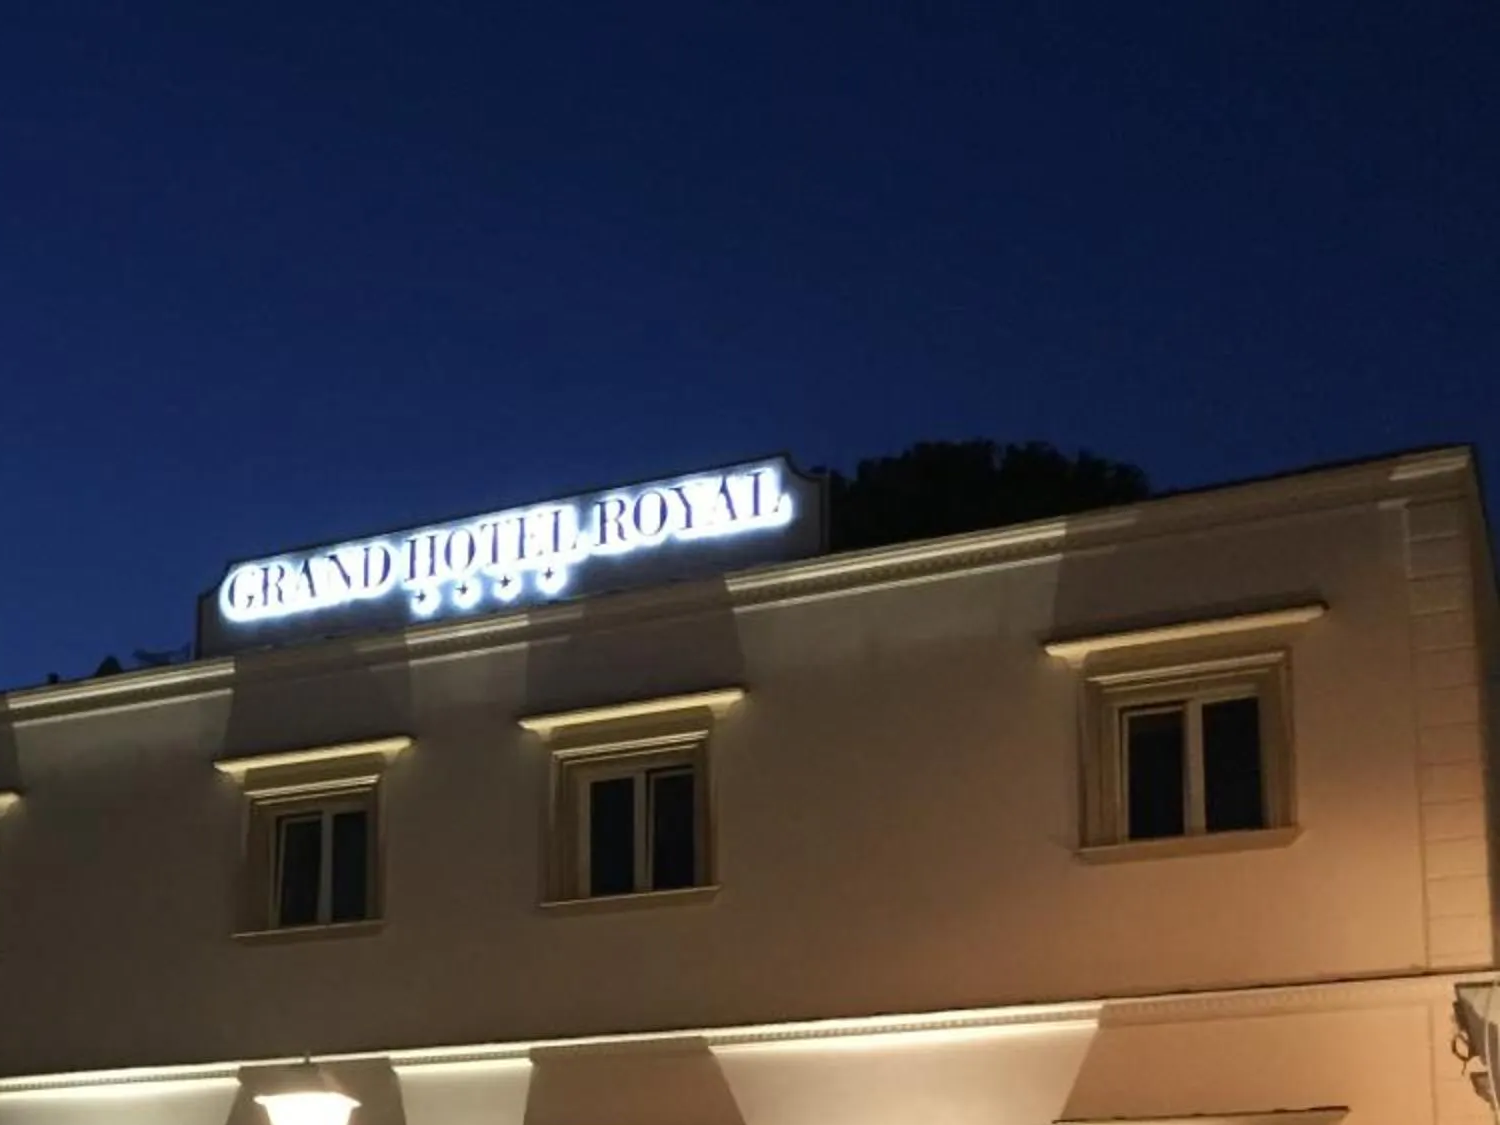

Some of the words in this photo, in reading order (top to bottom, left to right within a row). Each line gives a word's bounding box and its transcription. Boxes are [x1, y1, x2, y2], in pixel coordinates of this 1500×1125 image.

[226, 544, 392, 609] GRAND
[404, 509, 579, 582] HOTEL
[594, 471, 783, 546] ROYAL
